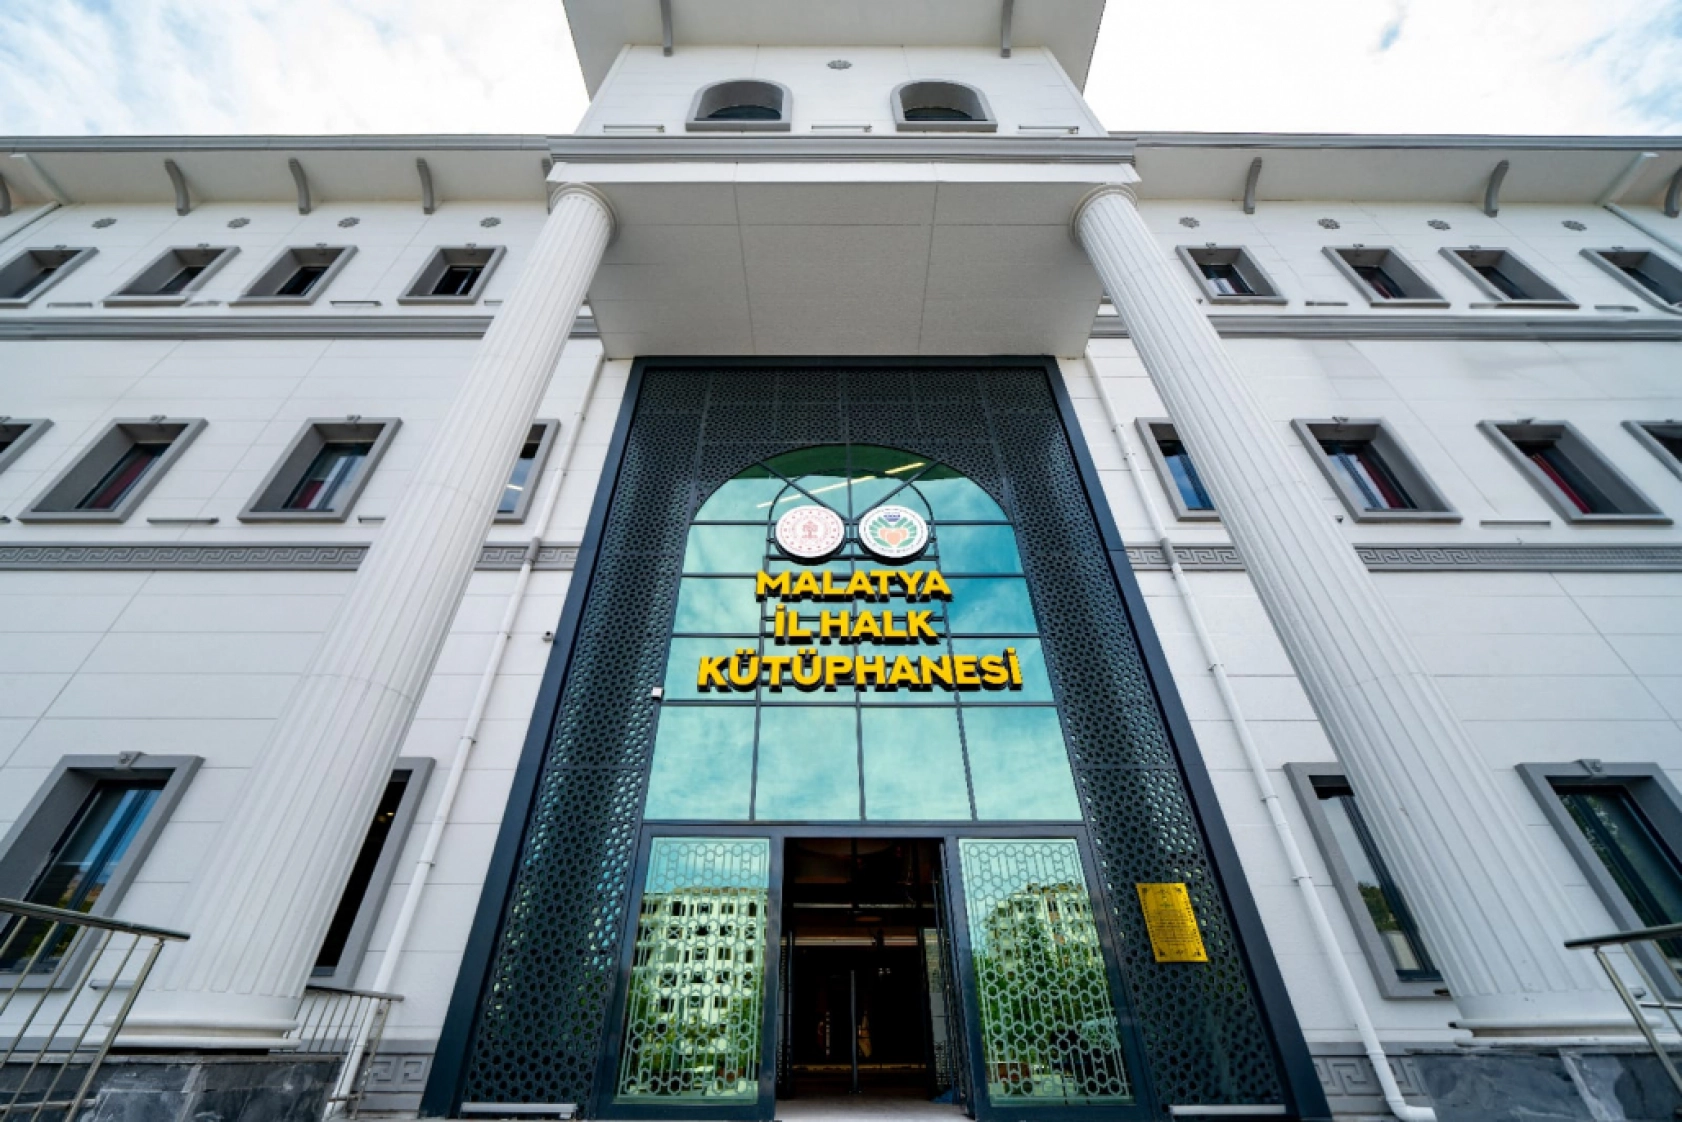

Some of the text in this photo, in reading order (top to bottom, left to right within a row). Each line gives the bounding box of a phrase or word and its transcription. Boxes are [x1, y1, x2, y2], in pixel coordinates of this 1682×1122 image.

[755, 570, 951, 596] MALATYA
[774, 604, 936, 638] İL HALK
[696, 647, 1022, 687] KÜTÜPHANESİ
